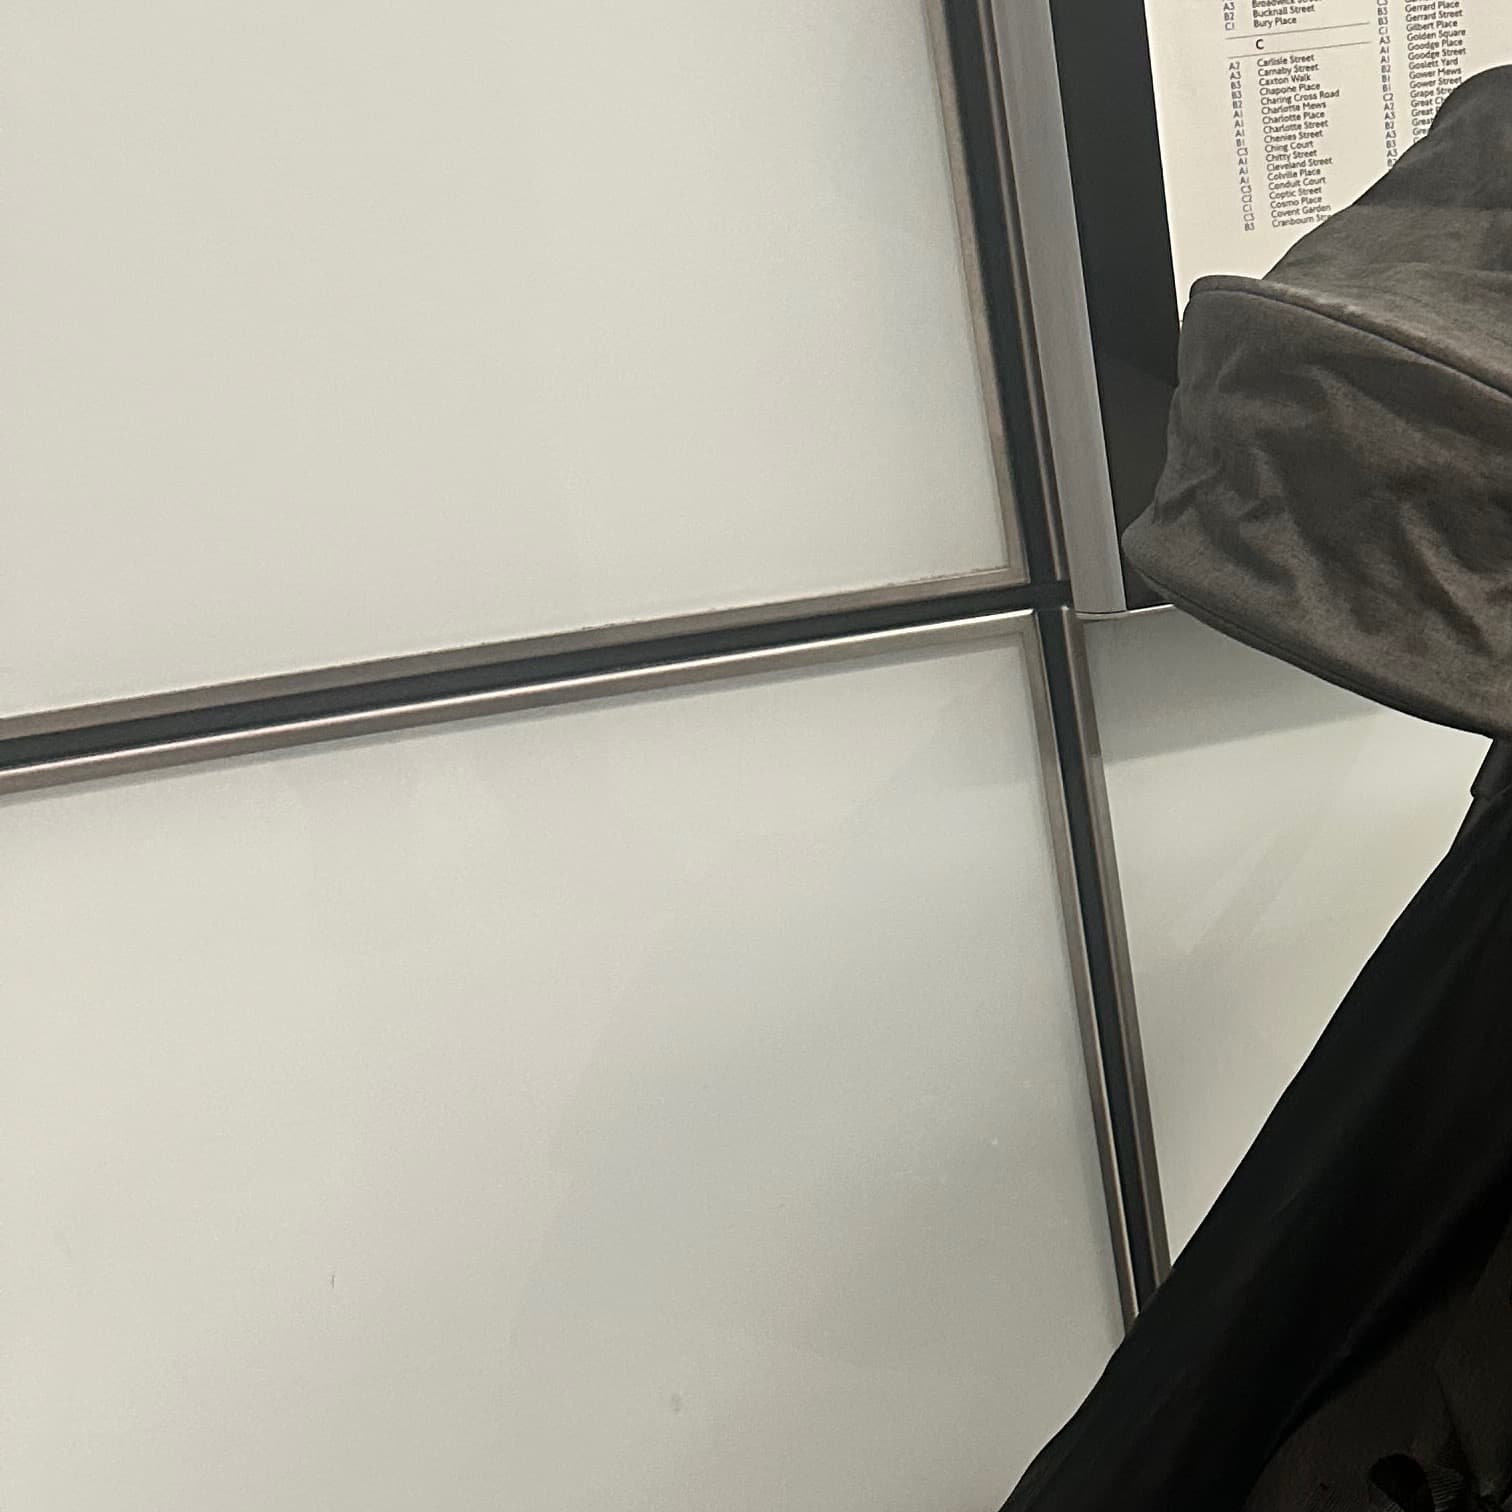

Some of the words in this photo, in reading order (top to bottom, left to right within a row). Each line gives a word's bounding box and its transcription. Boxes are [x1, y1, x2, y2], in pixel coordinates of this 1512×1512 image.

[1253, 7, 1288, 18] Bucknall
[1290, 4, 1316, 14] Street
[1404, 3, 1436, 12] Gerrard
[1438, 1, 1460, 9] Place
[1254, 18, 1273, 28] Bury
[1275, 16, 1297, 25] Place
[1406, 12, 1436, 22] Gerrard
[1438, 10, 1462, 18] Street
[1406, 22, 1434, 32] Gilbert
[1436, 20, 1458, 28] Place
[1407, 32, 1436, 41] Golden
[1438, 29, 1466, 40] Square
[1256, 39, 1264, 50] C
[1408, 40, 1440, 51] Goodge
[1442, 38, 1462, 47] Place
[1408, 50, 1440, 60] Goodge
[1442, 48, 1466, 56] Street
[1257, 57, 1288, 67] Carlisle
[1289, 54, 1315, 63] Street
[1408, 60, 1438, 70] Goslett
[1440, 58, 1458, 66] Yard
[1258, 66, 1292, 76] Carnaby
[1294, 64, 1319, 72] Street
[1409, 70, 1436, 79] Gower
[1438, 68, 1462, 76] Mews
[1258, 76, 1288, 86] Caxton
[1291, 74, 1311, 82] Walk
[1410, 79, 1436, 88] Gower
[1438, 76, 1462, 86] Street
[1260, 86, 1296, 96] Chapone
[1299, 83, 1320, 92] Place
[1410, 90, 1434, 99] Grape
[1436, 88, 1453, 96] Stre
[1260, 95, 1292, 105] Charing
[1294, 93, 1318, 102] Cross
[1320, 90, 1340, 98] Road
[1410, 98, 1432, 108] Great
[1262, 104, 1300, 115] Charlotte
[1302, 102, 1326, 110] Mews
[1412, 108, 1433, 117] Great
[1262, 114, 1301, 124] Charlotte
[1304, 111, 1326, 120] Place
[1263, 124, 1302, 134] Charlotte
[1304, 120, 1328, 128] Street
[1412, 128, 1426, 136] Gre
[1264, 134, 1296, 144] Chenies
[1298, 130, 1323, 139] Street
[1264, 144, 1288, 153] Ching
[1290, 140, 1314, 150] Court
[1266, 152, 1290, 162] Chitty
[1293, 150, 1318, 159] Street
[1266, 160, 1306, 172] Cleveland
[1308, 158, 1332, 166] Street
[1268, 170, 1298, 181] Colville
[1300, 168, 1321, 176] Place
[1268, 180, 1300, 190] Conduit
[1302, 177, 1326, 186] Court
[1269, 189, 1296, 200] Coptic
[1298, 186, 1322, 195] Street
[1270, 199, 1299, 209] Cosmo
[1301, 196, 1322, 204] Place
[1271, 208, 1300, 218] Covent
[1302, 204, 1332, 214] Garden
